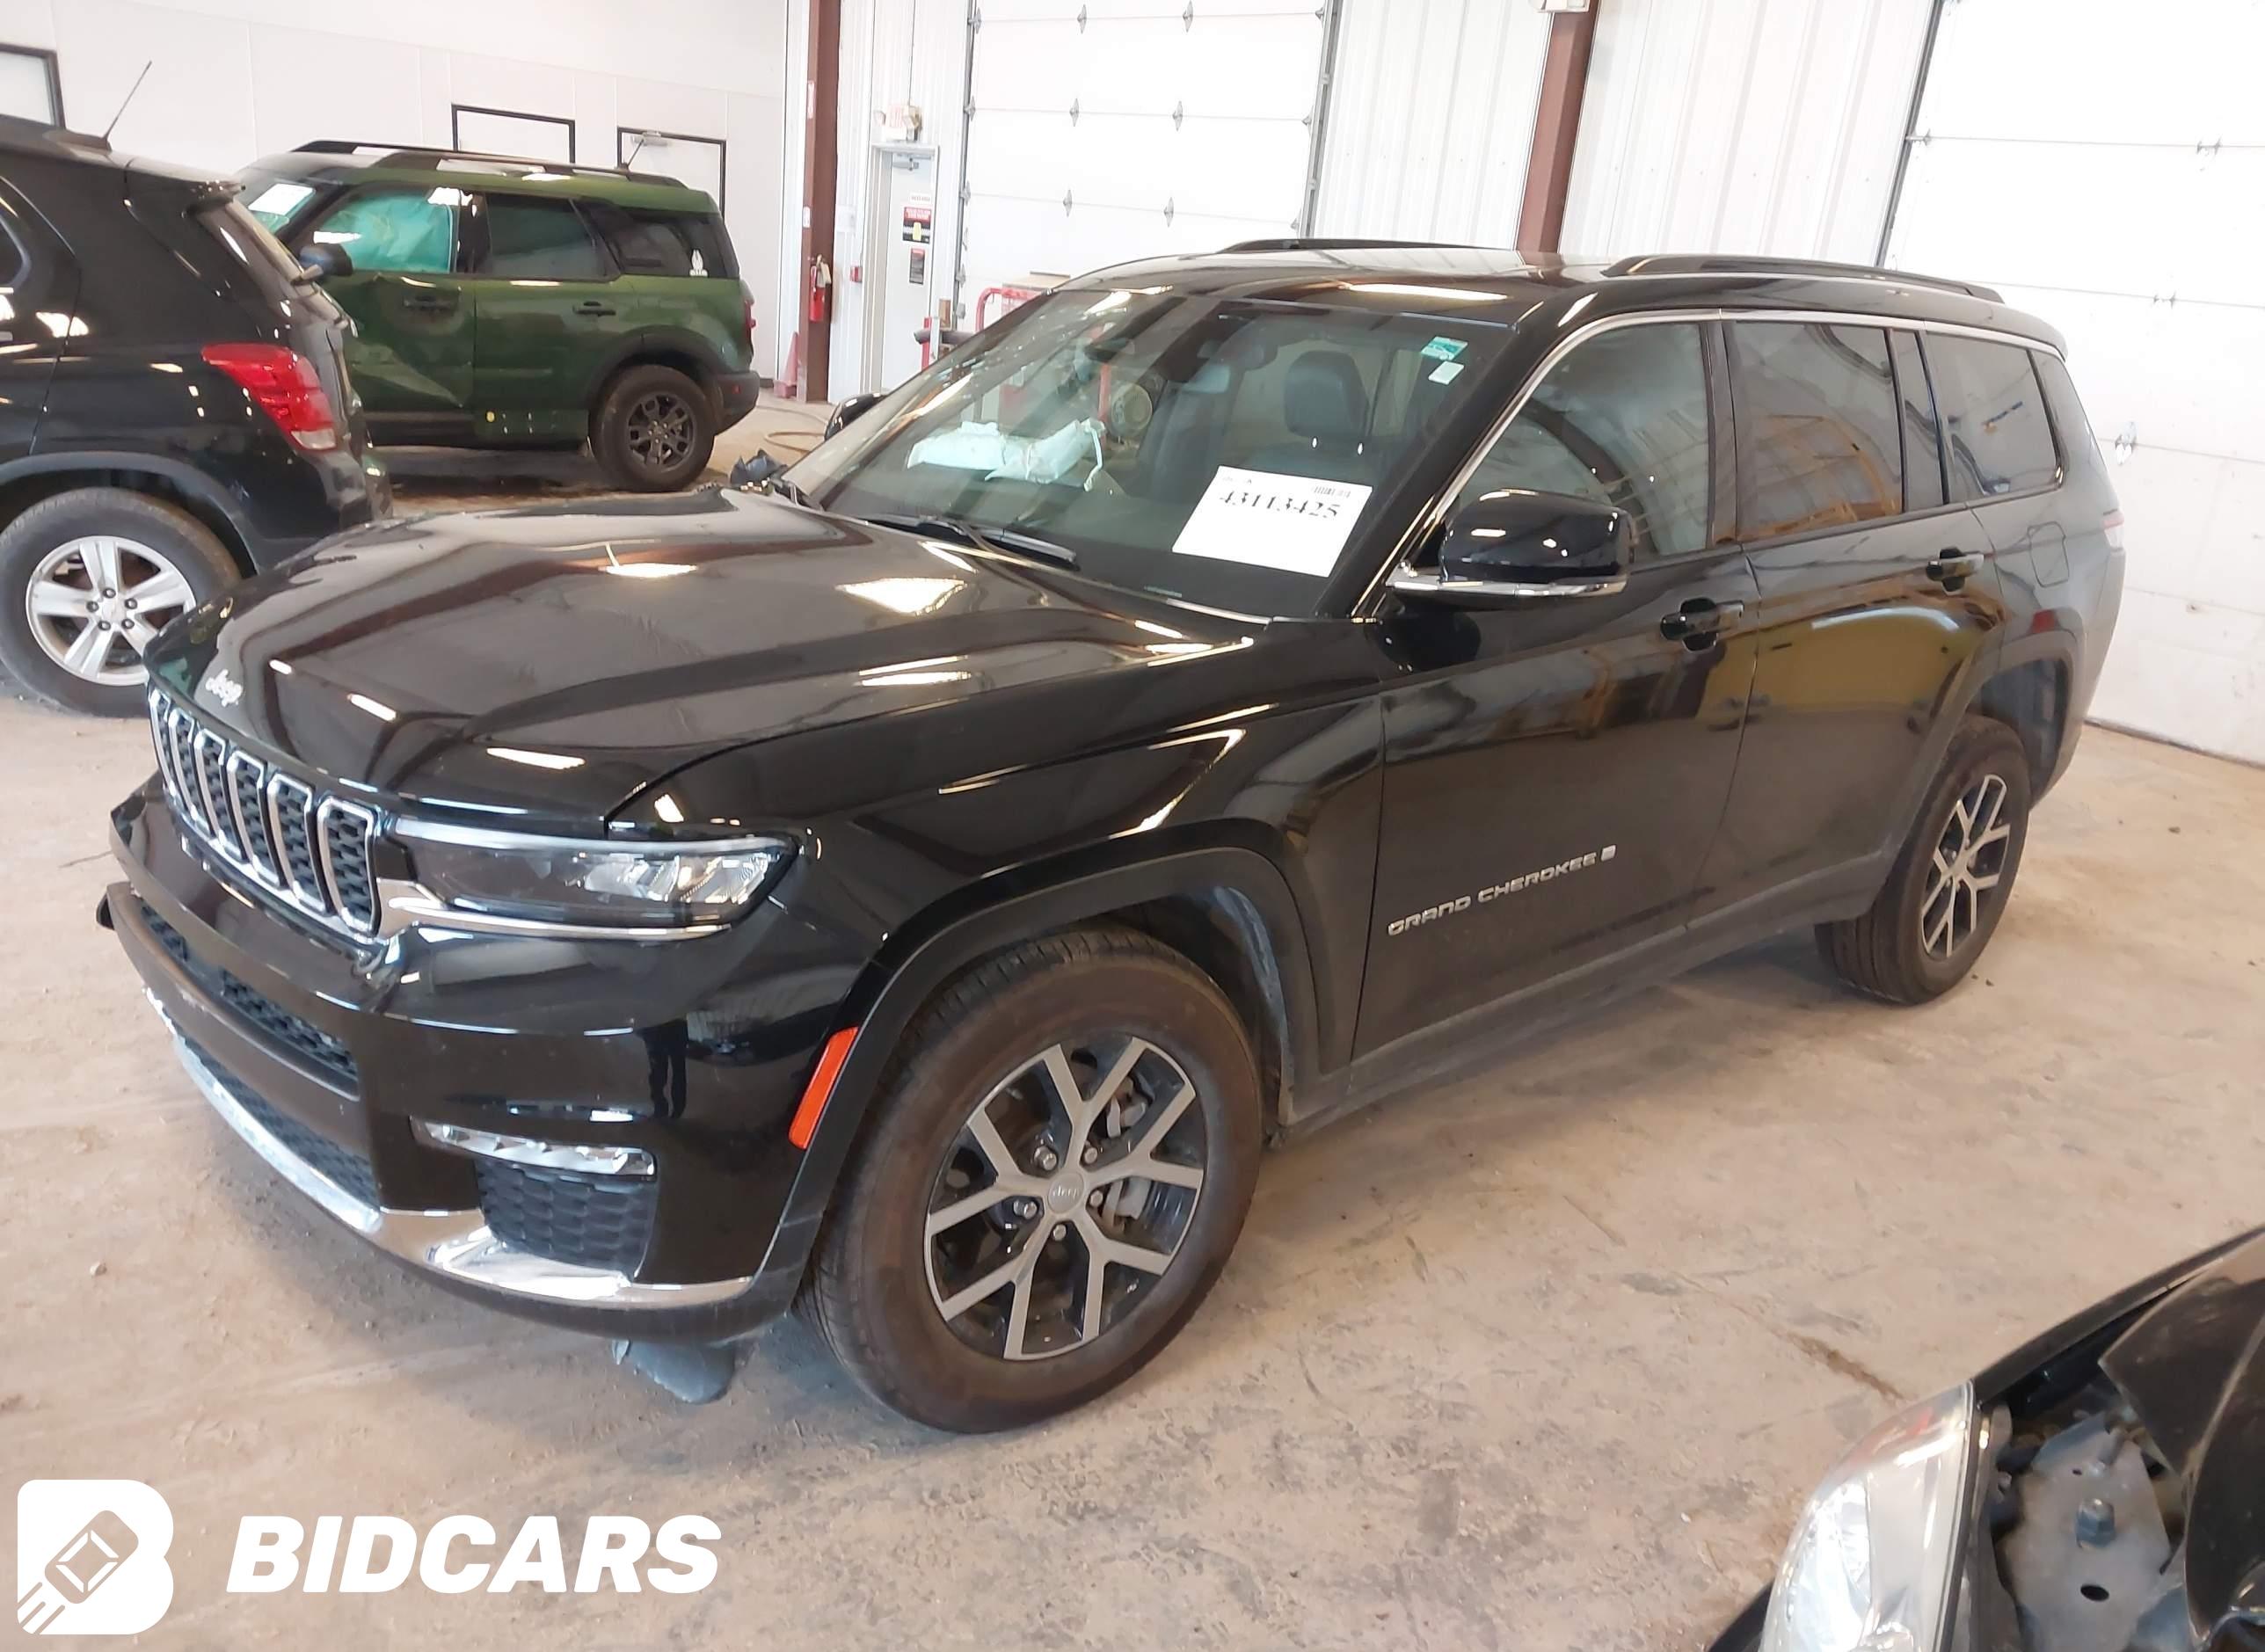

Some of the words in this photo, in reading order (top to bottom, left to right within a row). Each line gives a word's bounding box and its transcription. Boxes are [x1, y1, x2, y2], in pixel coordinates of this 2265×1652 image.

[1220, 491, 1341, 519] 43113425
[1387, 896, 1472, 936] GRAND
[1477, 852, 1597, 903] CHEROKEE
